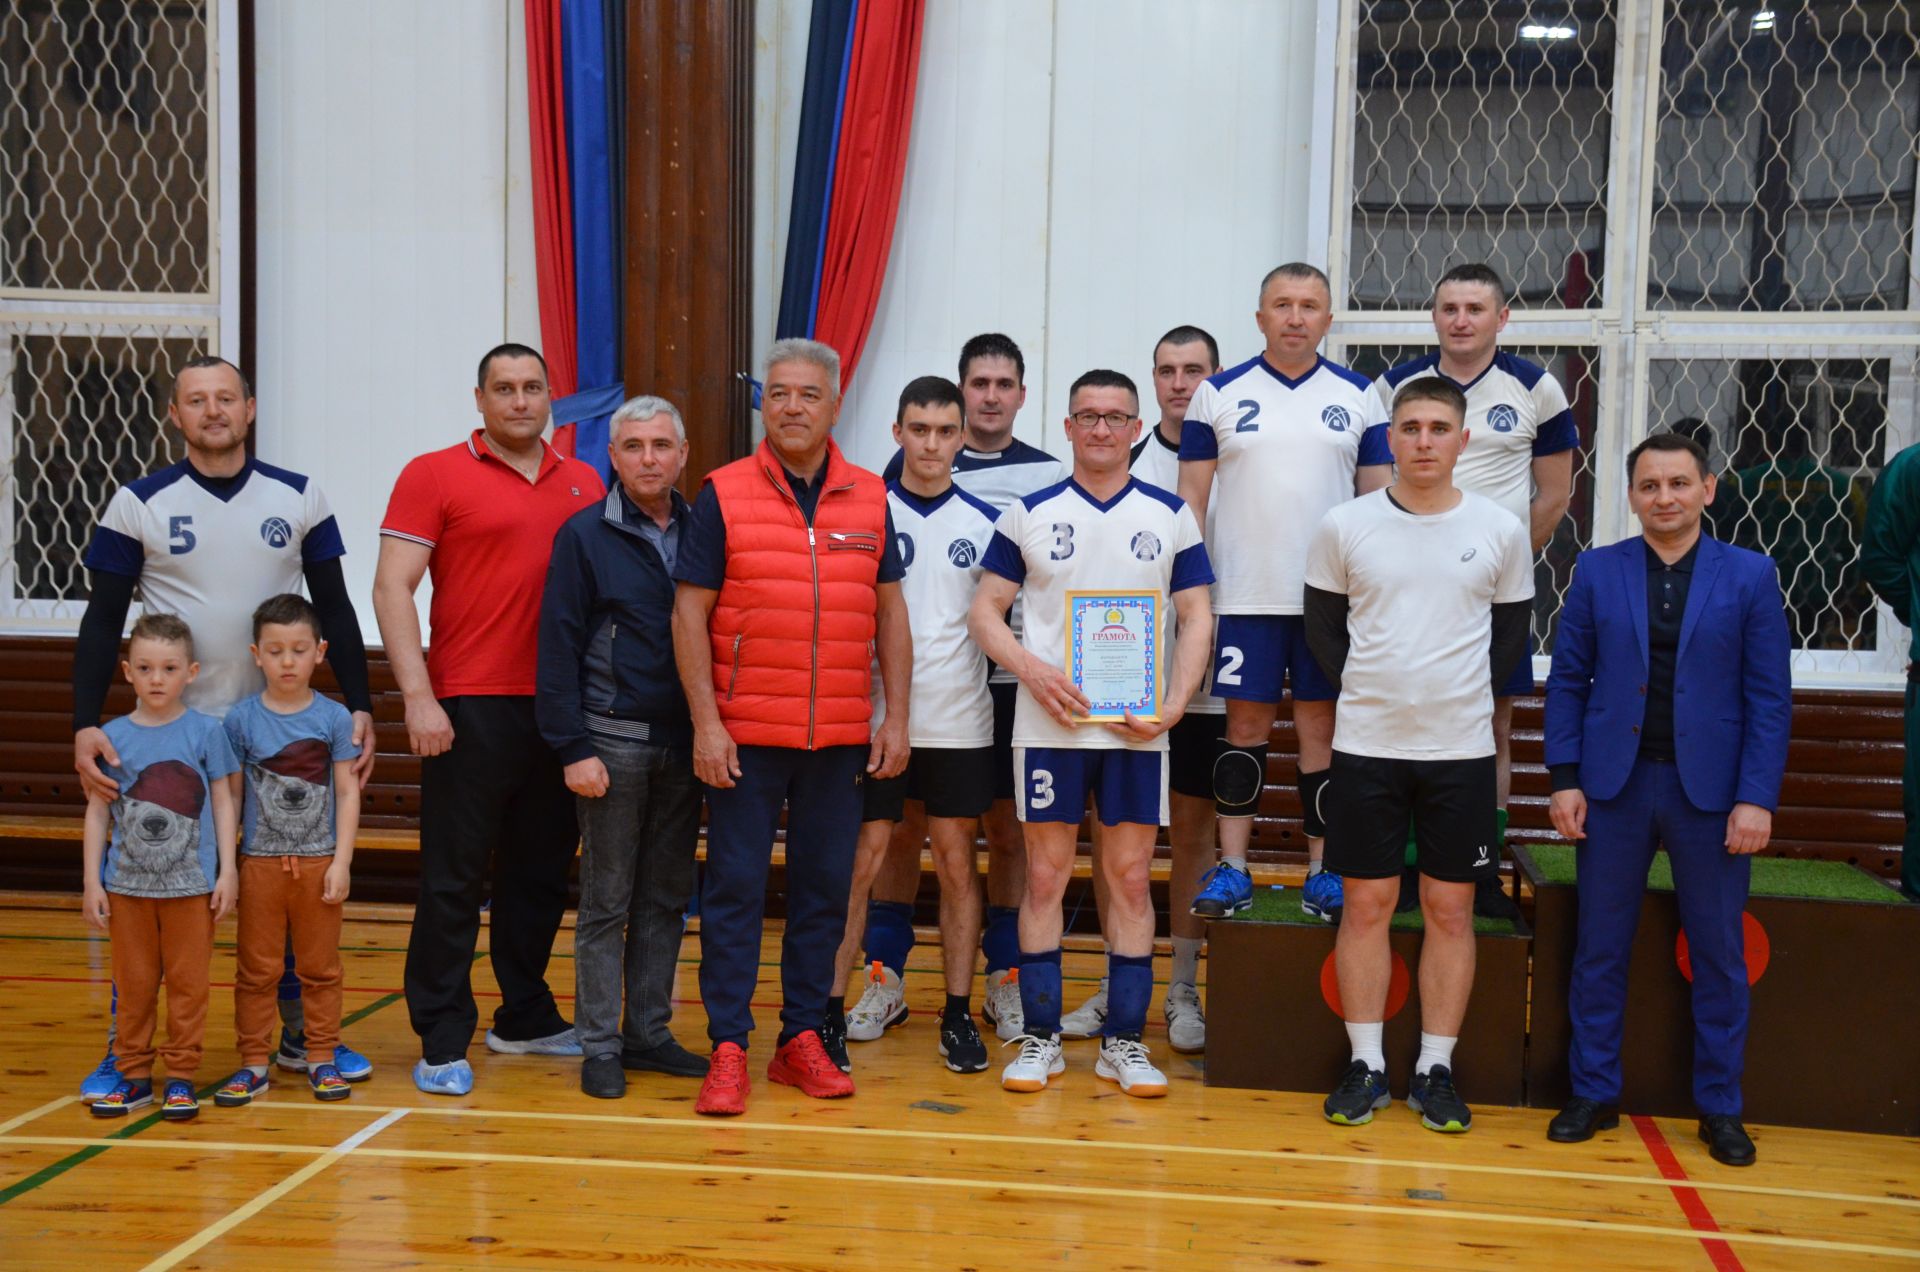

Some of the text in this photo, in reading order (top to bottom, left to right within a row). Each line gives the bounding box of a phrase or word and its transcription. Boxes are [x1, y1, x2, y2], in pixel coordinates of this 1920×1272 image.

[1236, 399, 1260, 433] 2
[169, 515, 196, 555] 5
[1050, 522, 1074, 561] 3
[1092, 632, 1137, 641] ГРАМОТА
[1217, 646, 1244, 686] 2
[1031, 769, 1055, 809] 3
